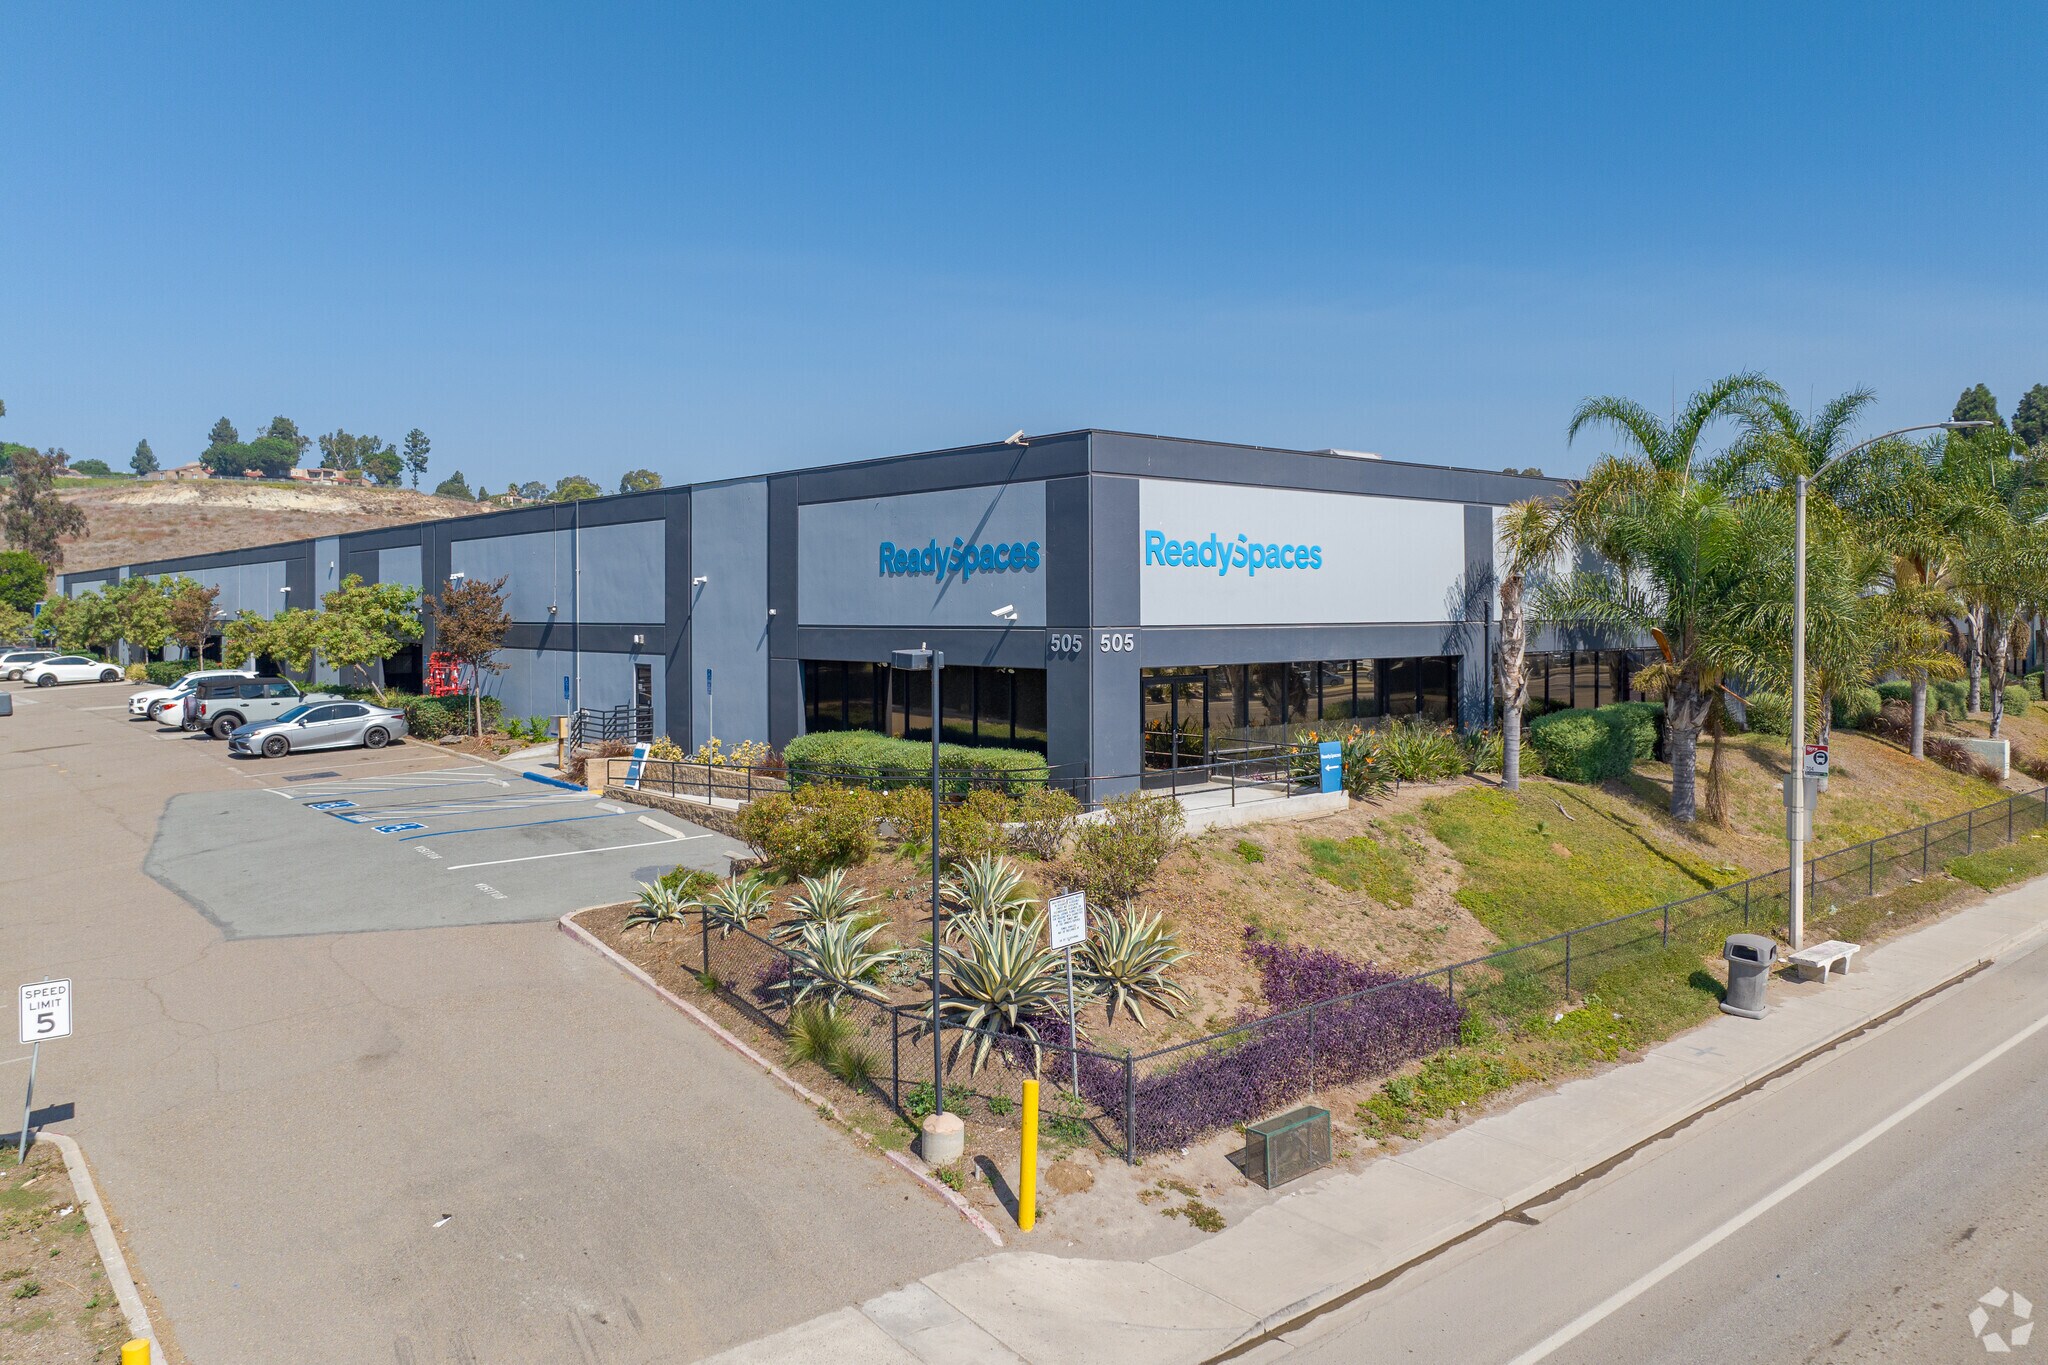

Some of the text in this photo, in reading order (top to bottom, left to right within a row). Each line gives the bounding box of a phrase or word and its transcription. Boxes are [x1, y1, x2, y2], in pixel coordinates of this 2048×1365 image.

[880, 537, 1041, 580] ReadySpaces
[1145, 530, 1323, 577] ReadySpaces
[1051, 633, 1082, 652] 505
[1100, 633, 1134, 652] 505
[25, 986, 66, 999] SPEED
[30, 998, 61, 1011] LIMIT
[37, 1012, 55, 1034] 5
